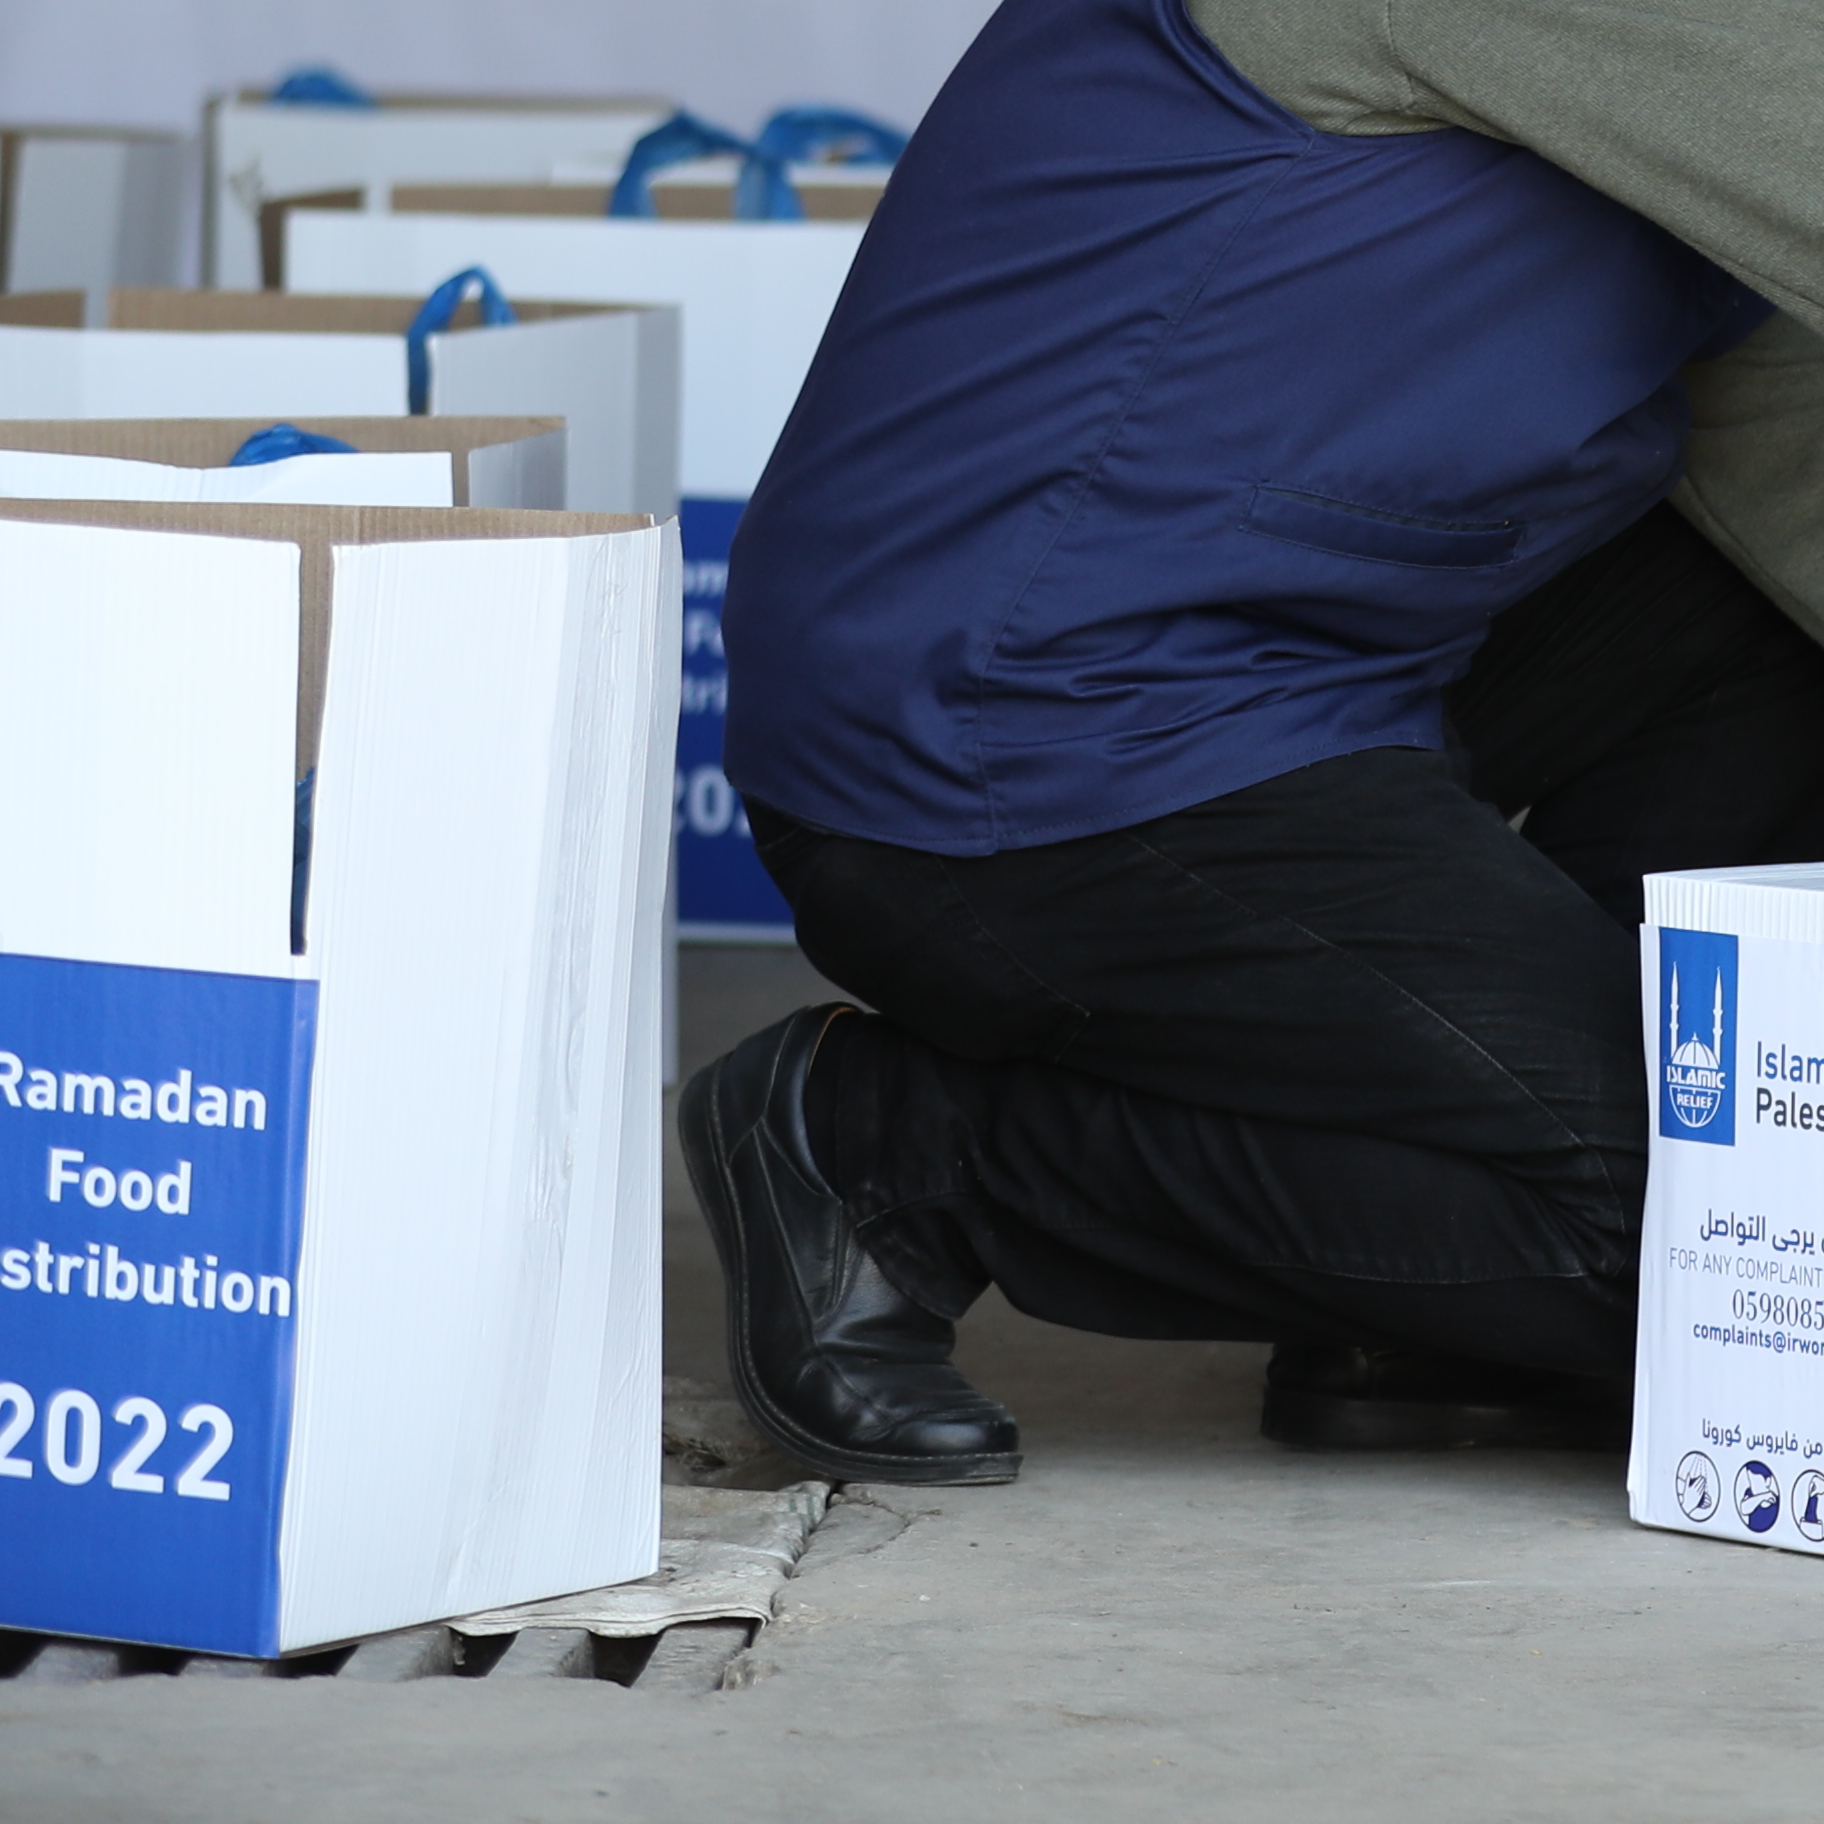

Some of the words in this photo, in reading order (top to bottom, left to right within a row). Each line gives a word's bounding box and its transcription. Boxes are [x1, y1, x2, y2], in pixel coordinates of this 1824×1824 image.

[1666, 1065, 1726, 1090] ISLAMIC
[1676, 1092, 1714, 1110] RELIEF
[47, 1146, 193, 1216] Food
[1700, 1208, 1766, 1246] التواصل
[1772, 1228, 1815, 1255] يرجى
[0, 1239, 292, 1317] stribution
[1669, 1247, 1698, 1272] FOR
[1702, 1252, 1733, 1276] ANY
[1736, 1257, 1824, 1288] COMPLAINT
[0, 1380, 234, 1502] 2022
[1702, 1417, 1742, 1448] كورونا
[1746, 1430, 1799, 1455] فايروس
[1803, 1438, 1823, 1459] من
